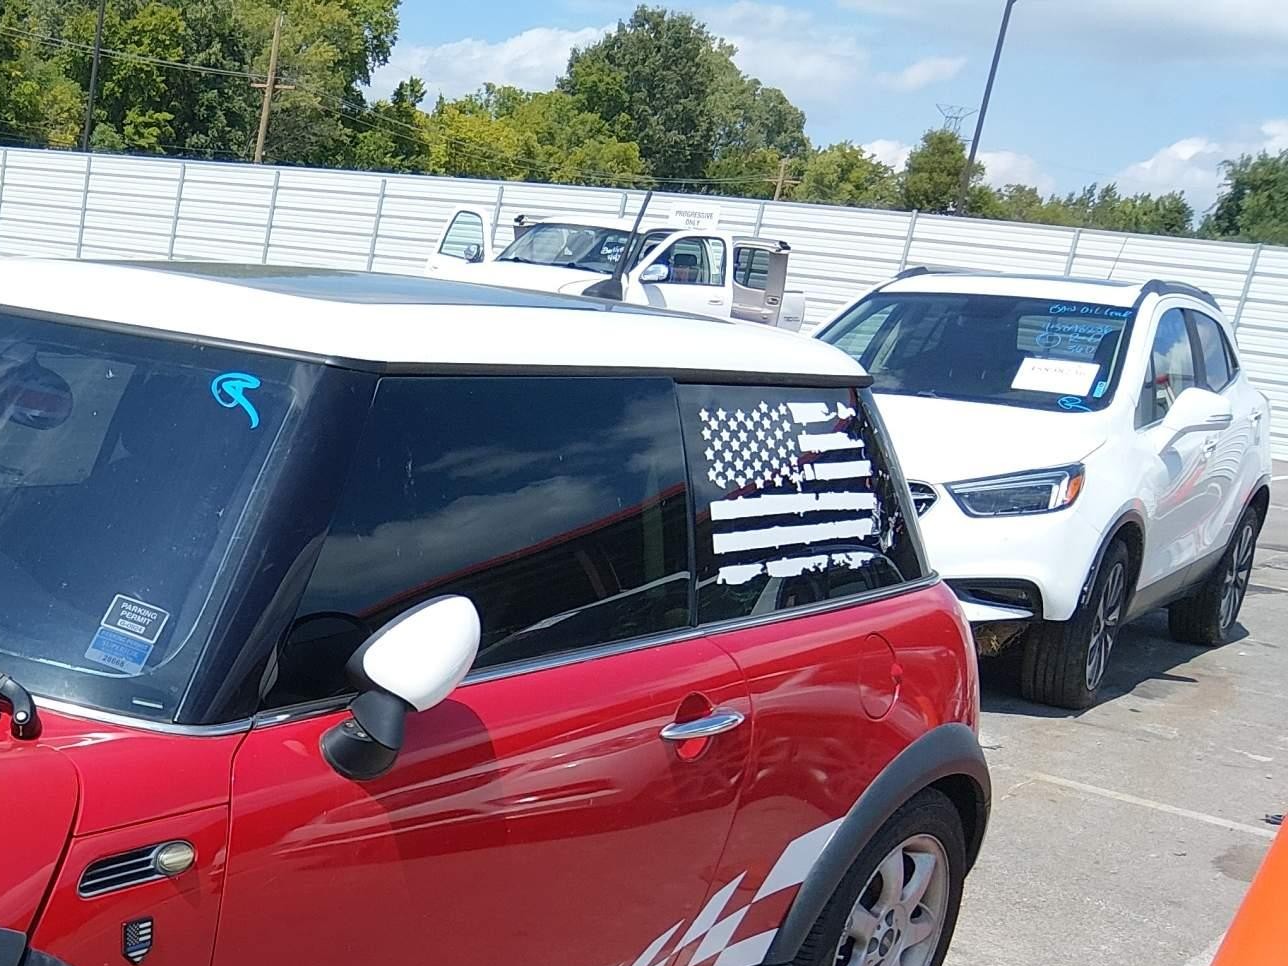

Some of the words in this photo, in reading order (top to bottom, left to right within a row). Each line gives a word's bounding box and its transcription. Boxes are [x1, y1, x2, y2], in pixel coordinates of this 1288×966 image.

[675, 210, 714, 219] PROGRESSIVE
[685, 218, 700, 226] ONLY
[121, 602, 158, 620] PARKING
[120, 610, 152, 625] PERMIT
